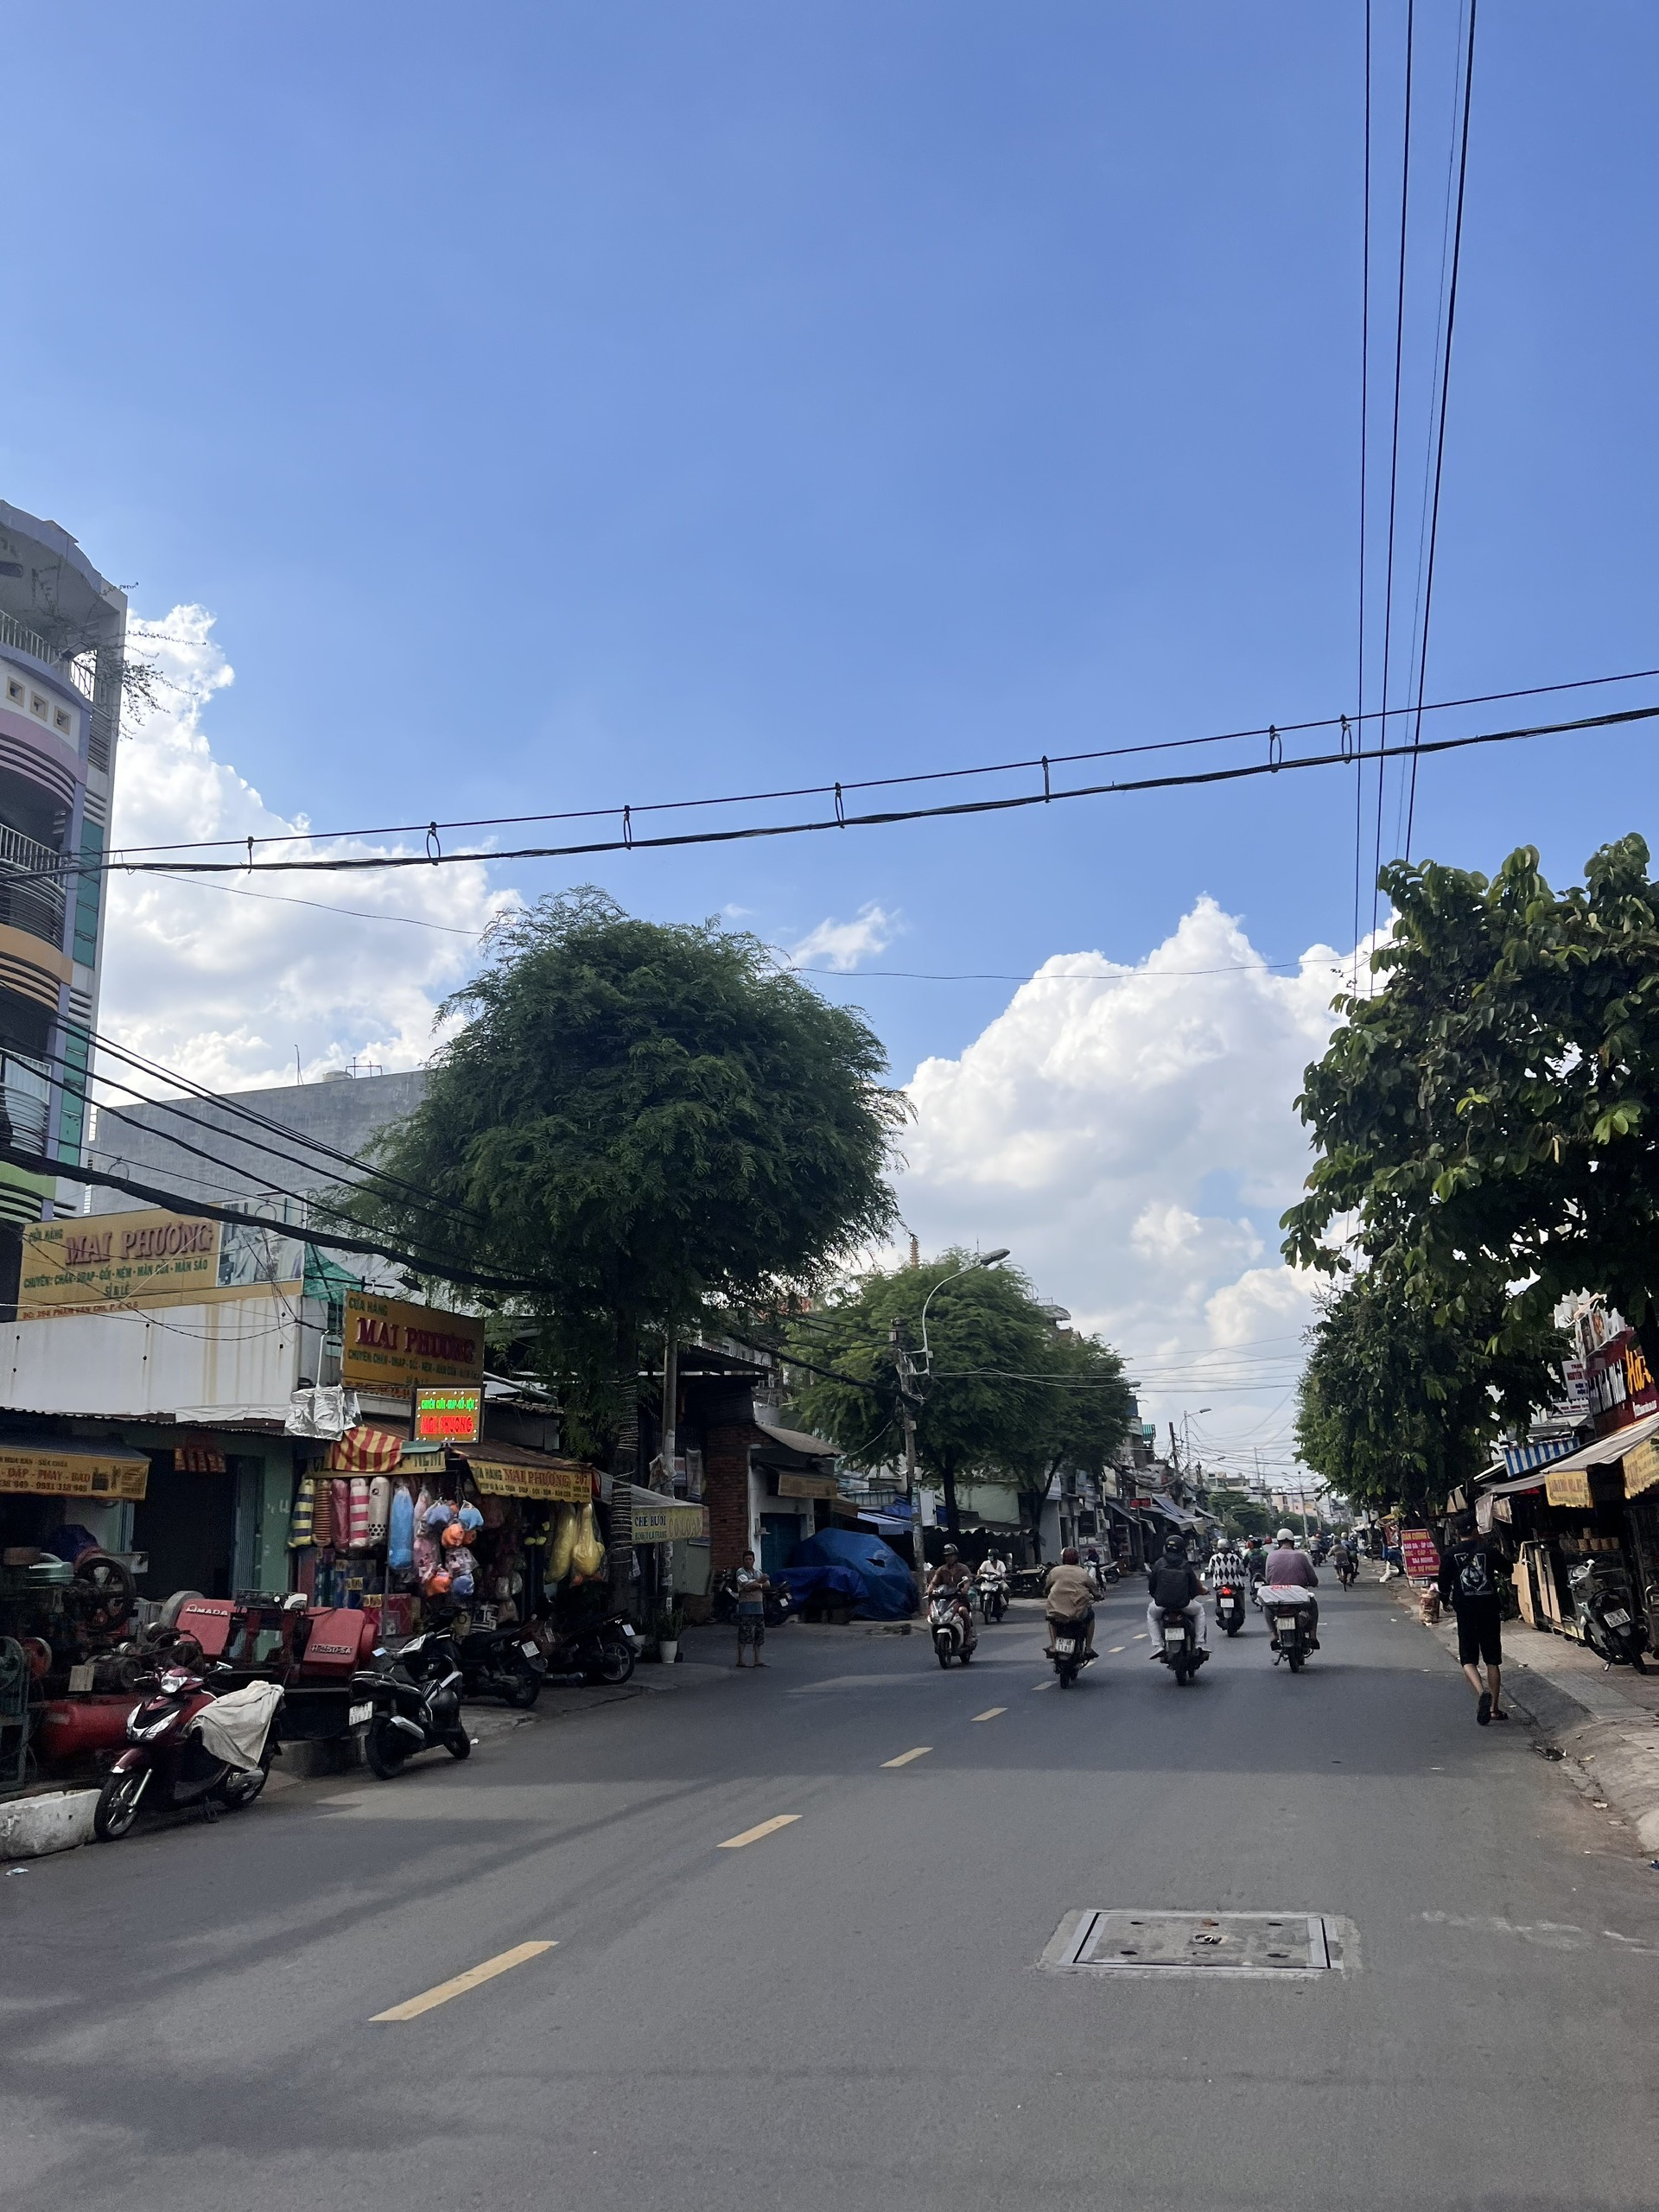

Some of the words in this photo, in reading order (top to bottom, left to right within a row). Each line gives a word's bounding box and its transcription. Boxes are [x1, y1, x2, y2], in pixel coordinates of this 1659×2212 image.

[65, 1232, 113, 1265] MAI
[355, 1317, 399, 1351] MAI
[502, 1469, 526, 1484] MAI
[186, 1604, 228, 1617] AMADA
